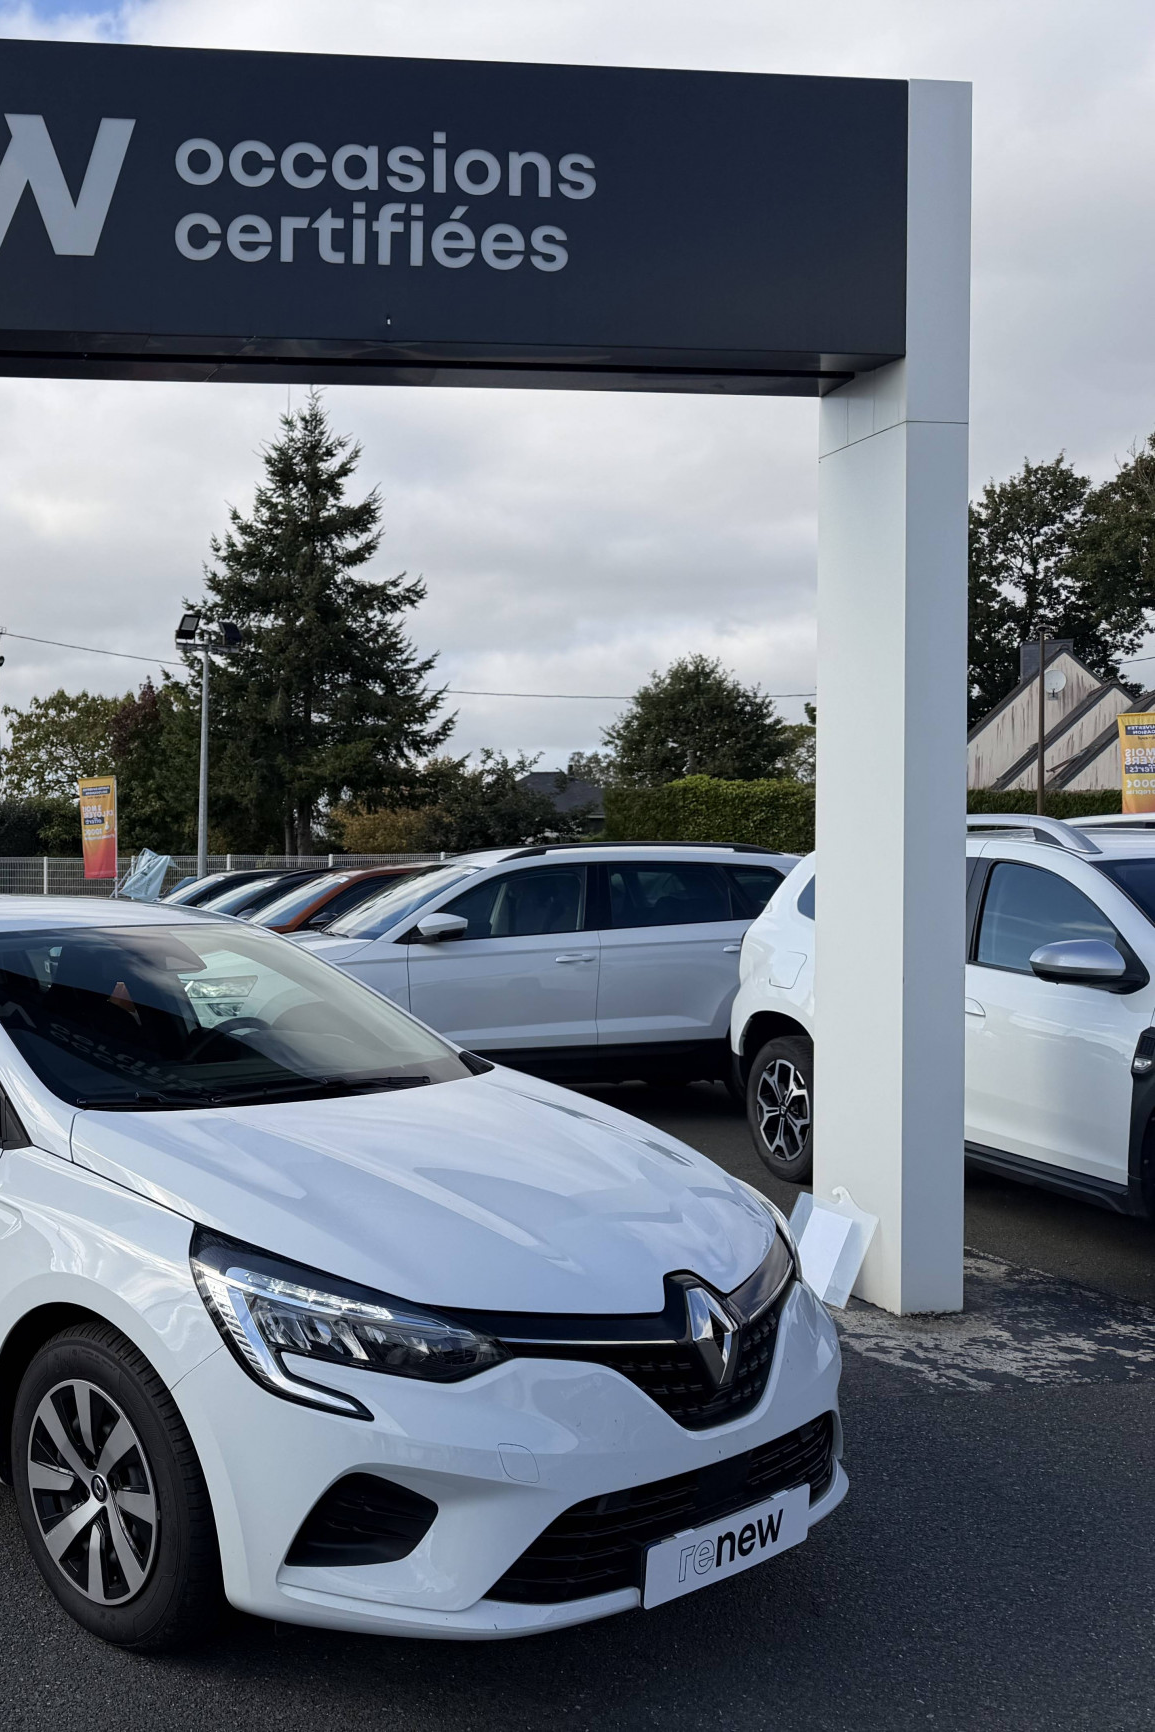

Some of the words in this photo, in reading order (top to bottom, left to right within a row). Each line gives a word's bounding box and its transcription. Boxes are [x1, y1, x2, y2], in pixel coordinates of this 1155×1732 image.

[175, 131, 597, 200] occasions
[175, 201, 569, 272] certifiées
[678, 1508, 784, 1583] renew
